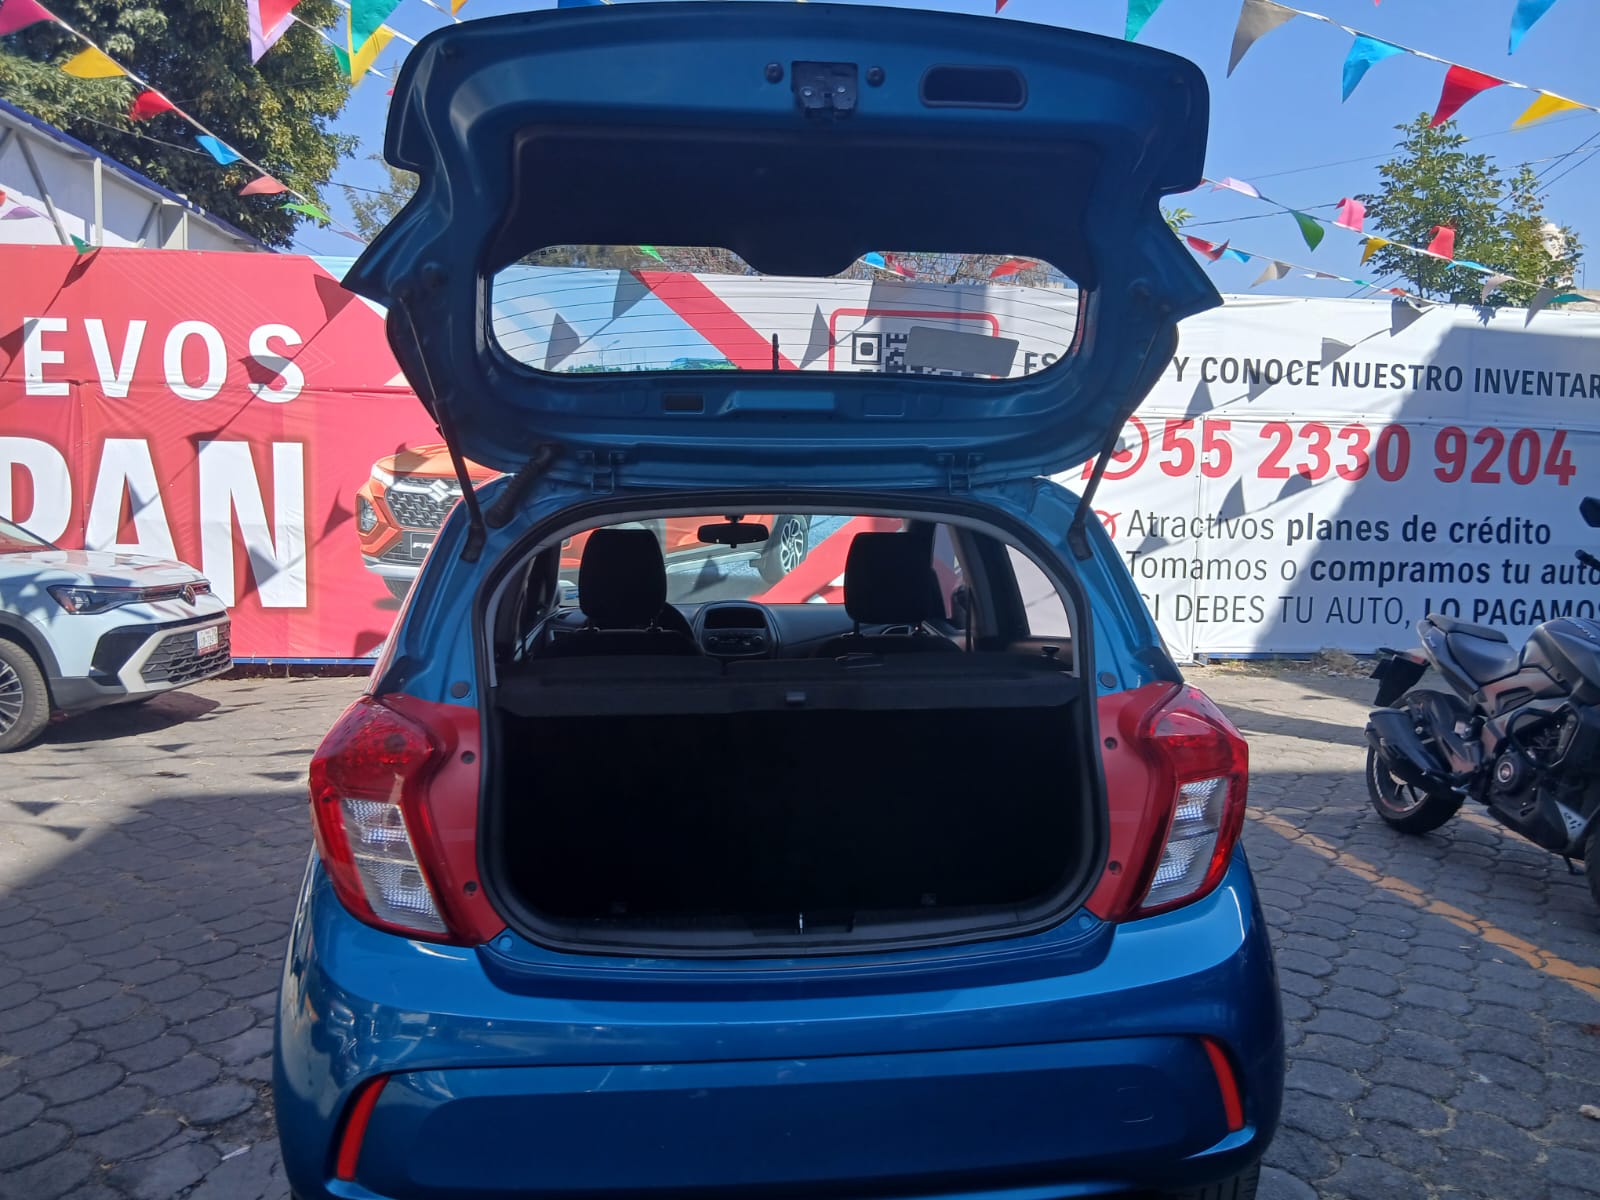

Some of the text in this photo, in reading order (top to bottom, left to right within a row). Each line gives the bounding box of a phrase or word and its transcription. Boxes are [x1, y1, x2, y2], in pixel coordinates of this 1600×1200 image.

[23, 316, 305, 404] EVOS
[1173, 356, 1190, 383] Y
[1201, 356, 1320, 386] CONOCE
[1331, 361, 1463, 393] NUESTRO
[1160, 419, 1577, 487] 55 2330 9204
[1127, 509, 1552, 547] Atractivos planes de crédito
[1126, 550, 1268, 582] Tomamos
[1280, 561, 1297, 582] o
[1309, 559, 1491, 588] compramos
[1501, 558, 1530, 585] tu
[1175, 594, 1265, 625] DEBES
[1278, 596, 1314, 624] TU
[1326, 596, 1411, 630] AUTO,
[1472, 598, 1600, 627] PAGAMO
